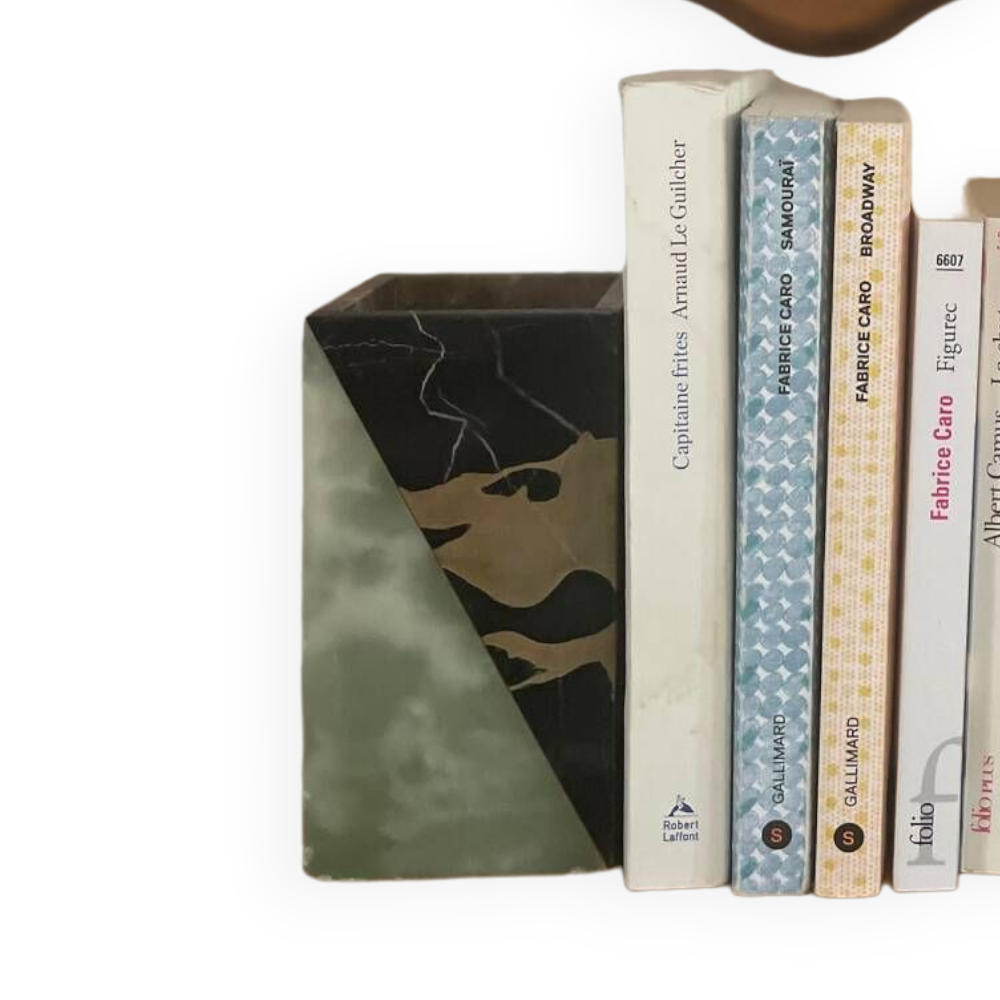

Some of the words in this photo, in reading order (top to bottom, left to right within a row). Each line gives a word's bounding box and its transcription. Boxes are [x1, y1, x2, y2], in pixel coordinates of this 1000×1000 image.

[668, 139, 687, 220] Guilcher
[778, 158, 795, 251] SAMOURAÏ
[860, 162, 876, 258] BROADWAY
[670, 224, 687, 246] Le
[936, 253, 964, 268] 6607
[671, 251, 688, 321] Arnaud
[779, 272, 793, 321] CARO
[858, 280, 873, 329] CARO
[671, 331, 689, 379] frites
[778, 323, 793, 396] FABRICE
[856, 331, 871, 405] FABRICE
[936, 301, 962, 373] Figurec
[671, 382, 693, 471] Capitaine
[933, 394, 953, 442] Caro
[929, 446, 951, 522] Fabrice
[772, 713, 786, 805] GALLIMARD
[844, 716, 860, 808] GALLIMARD
[662, 819, 699, 831] Robert
[662, 831, 699, 842] Laffont
[908, 801, 935, 847] folio
